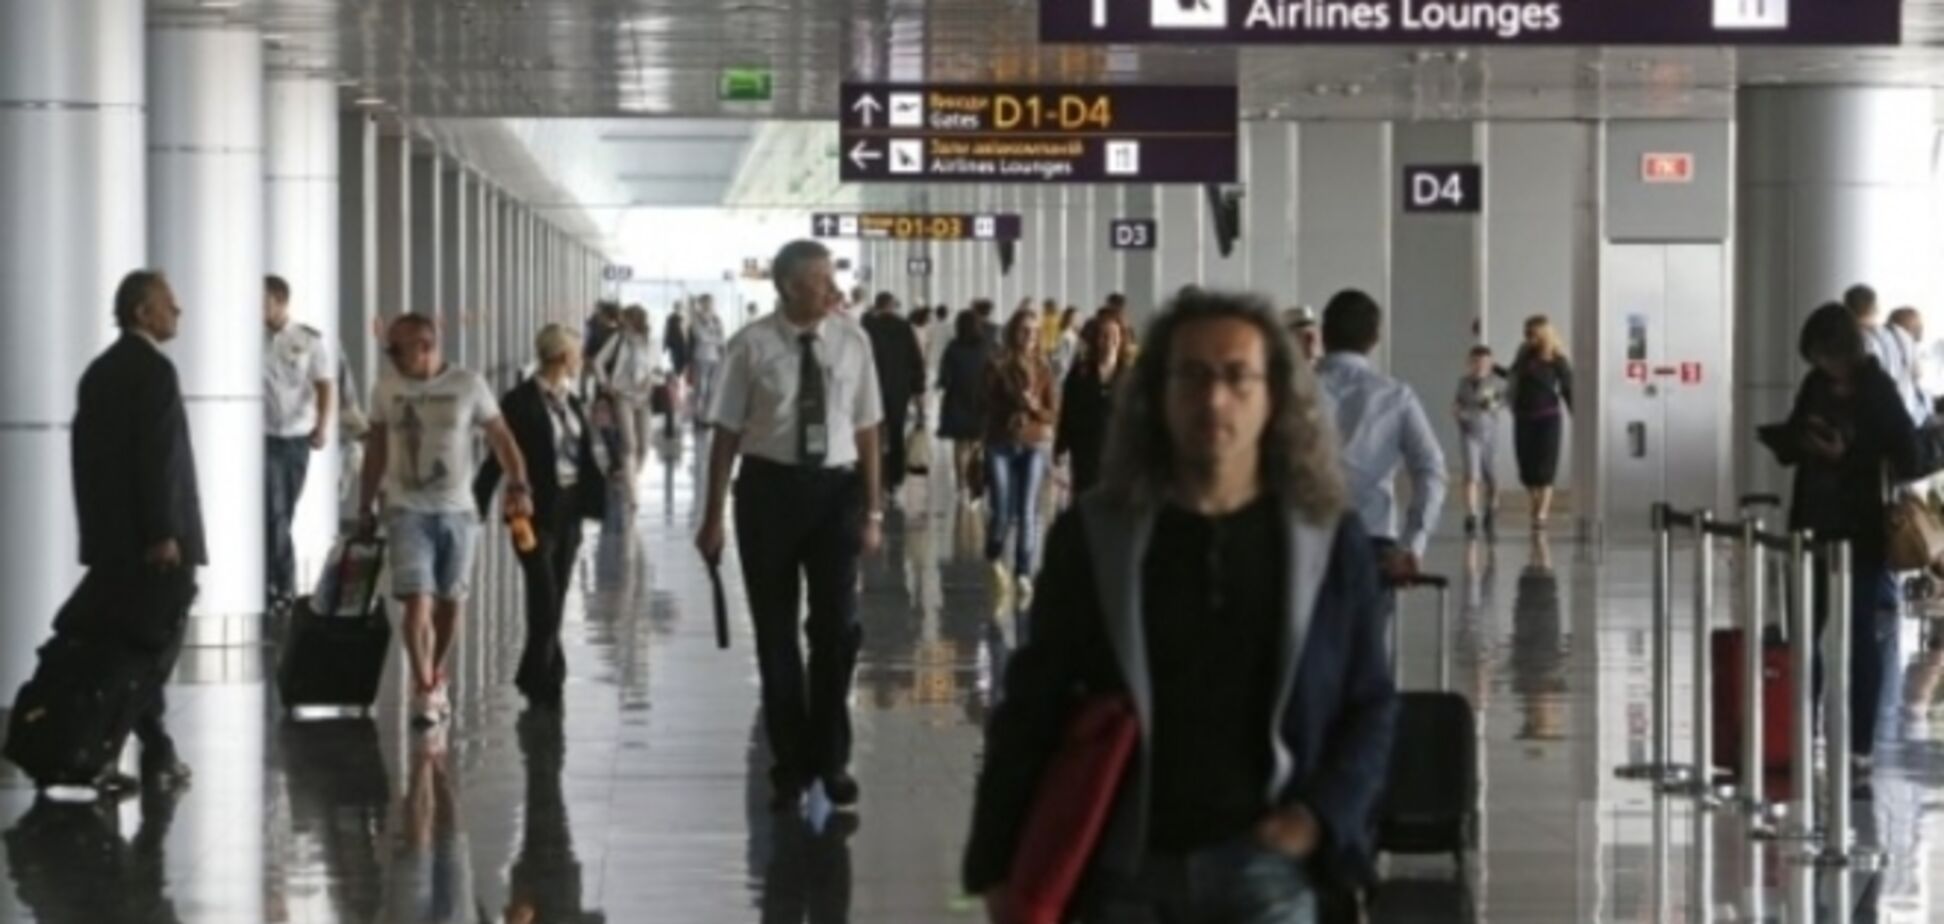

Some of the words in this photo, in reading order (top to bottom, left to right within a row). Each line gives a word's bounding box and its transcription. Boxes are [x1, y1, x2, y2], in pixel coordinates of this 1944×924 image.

[1244, 0, 1390, 29] Airlines
[1402, 0, 1561, 37] Lounges
[930, 112, 979, 128] Gates
[994, 95, 1111, 129] D1-D4
[931, 158, 994, 174] Airlines
[1000, 157, 1073, 179] Lounges
[1413, 172, 1463, 205] D4
[1116, 224, 1147, 246] D3
